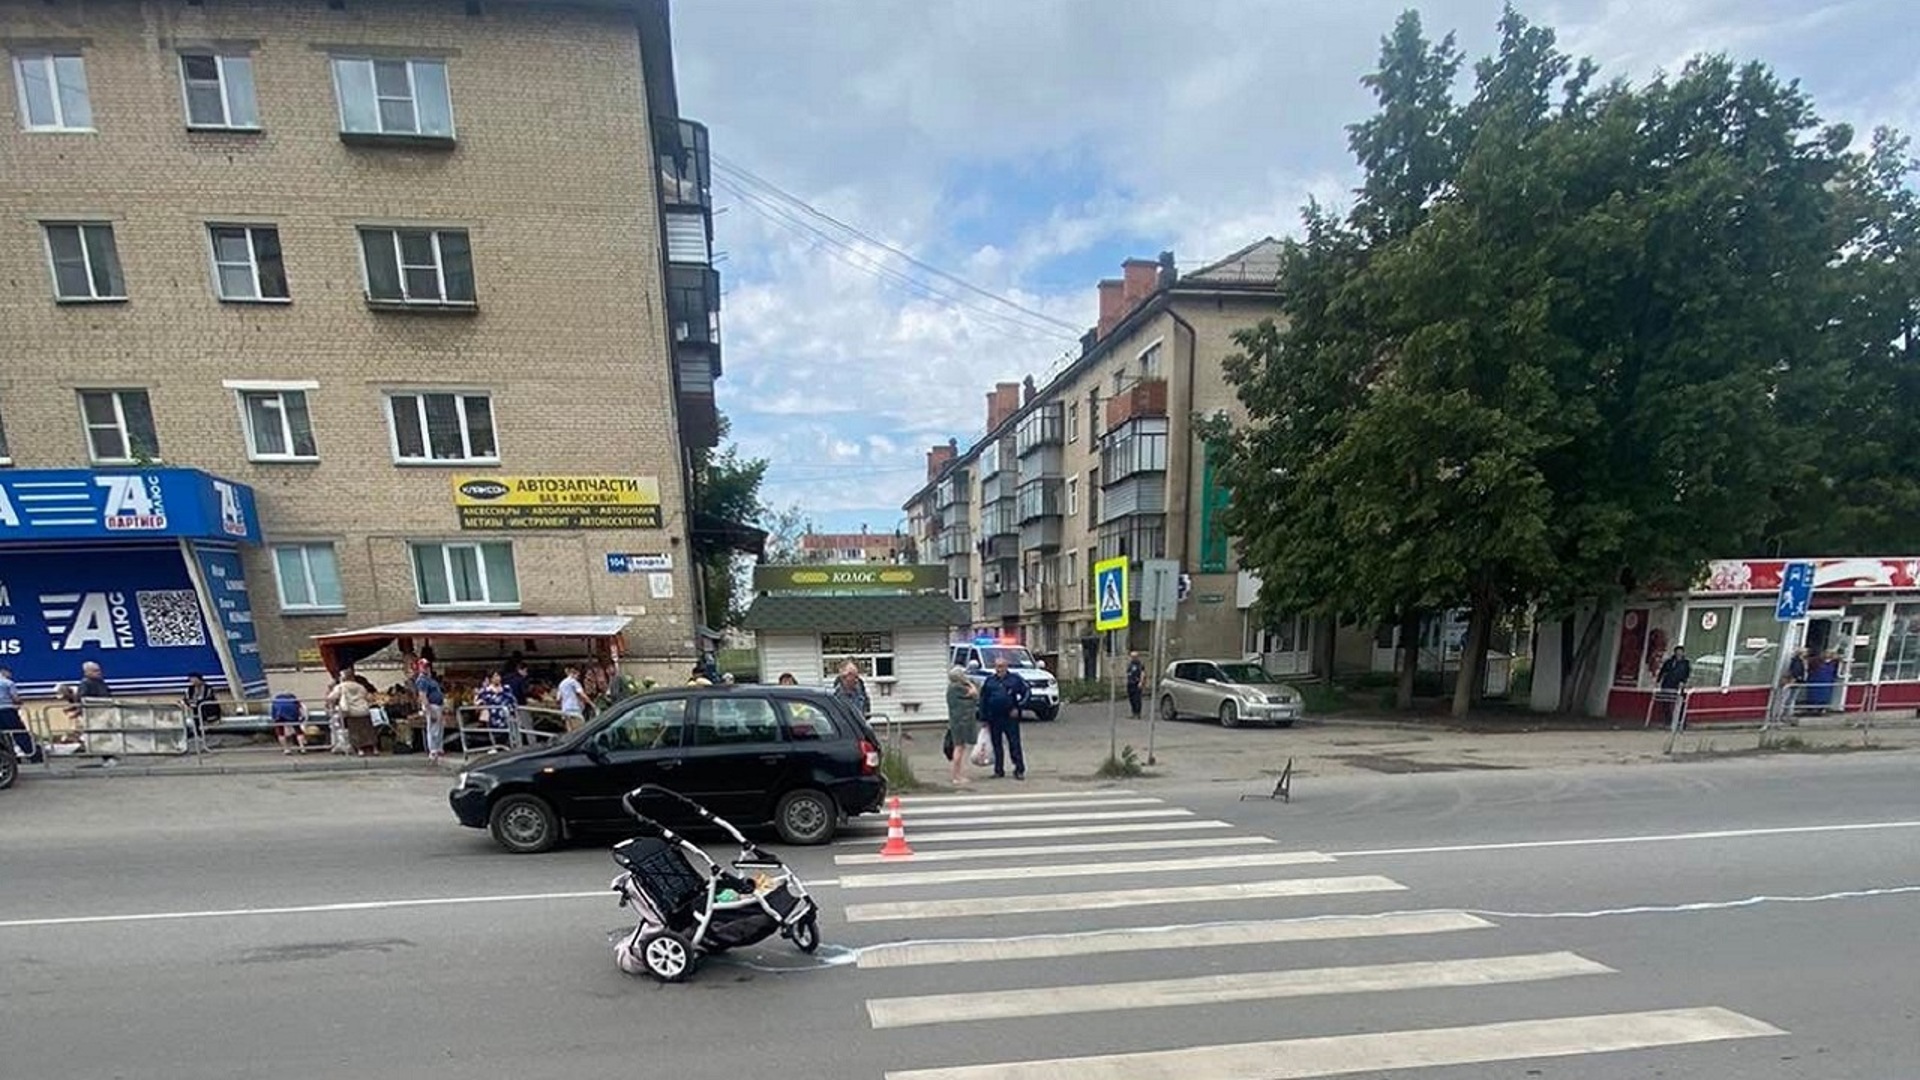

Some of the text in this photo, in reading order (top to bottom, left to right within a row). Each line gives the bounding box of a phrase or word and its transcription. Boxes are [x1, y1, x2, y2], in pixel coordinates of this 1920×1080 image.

[516, 479, 639, 493] АВТОЗАПЧАСТИ
[570, 493, 620, 503] МОСКВИЧ
[462, 506, 521, 515] АКСЕССУАРЫ
[600, 506, 656, 515] АВТОХИМИЯ
[109, 516, 164, 528] ПАРТНЕР
[464, 517, 656, 527] МЕТИЗЫ ИНСТРУМЕНТ АВТОКОСМЕТИКА
[609, 557, 625, 568] 104
[832, 572, 877, 583] КОЛОС
[109, 592, 135, 648] ПЛЮС
